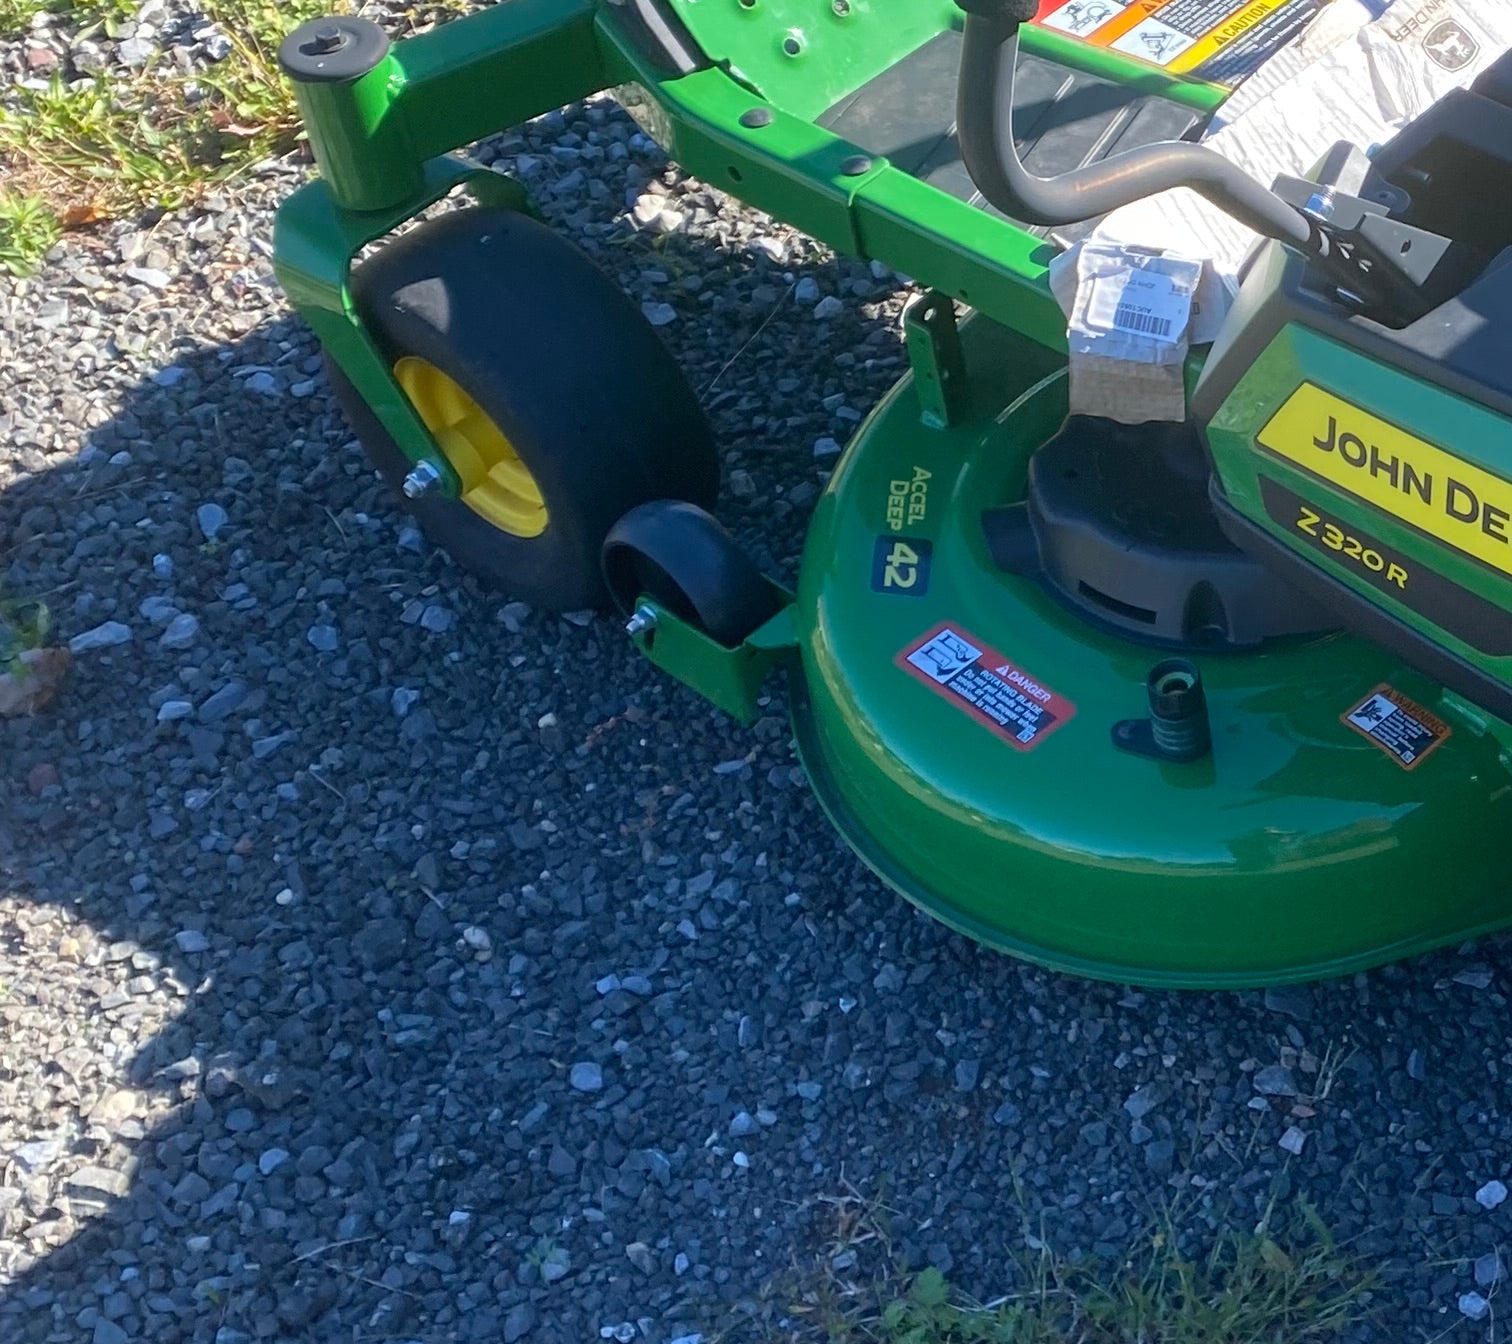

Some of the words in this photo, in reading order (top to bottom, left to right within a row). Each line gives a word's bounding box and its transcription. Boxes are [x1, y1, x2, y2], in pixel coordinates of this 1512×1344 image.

[1222, 2, 1271, 38] CAUTION
[1390, 9, 1429, 42] DEER
[1313, 416, 1432, 505] JOHN
[886, 480, 909, 531] DEEP
[907, 465, 932, 525] ACCEL
[884, 542, 918, 588] 42
[980, 670, 1018, 699] ROTATING
[1016, 695, 1044, 716] BLADE
[1007, 671, 1051, 703] DANGER
[1390, 690, 1447, 735] WARNING
